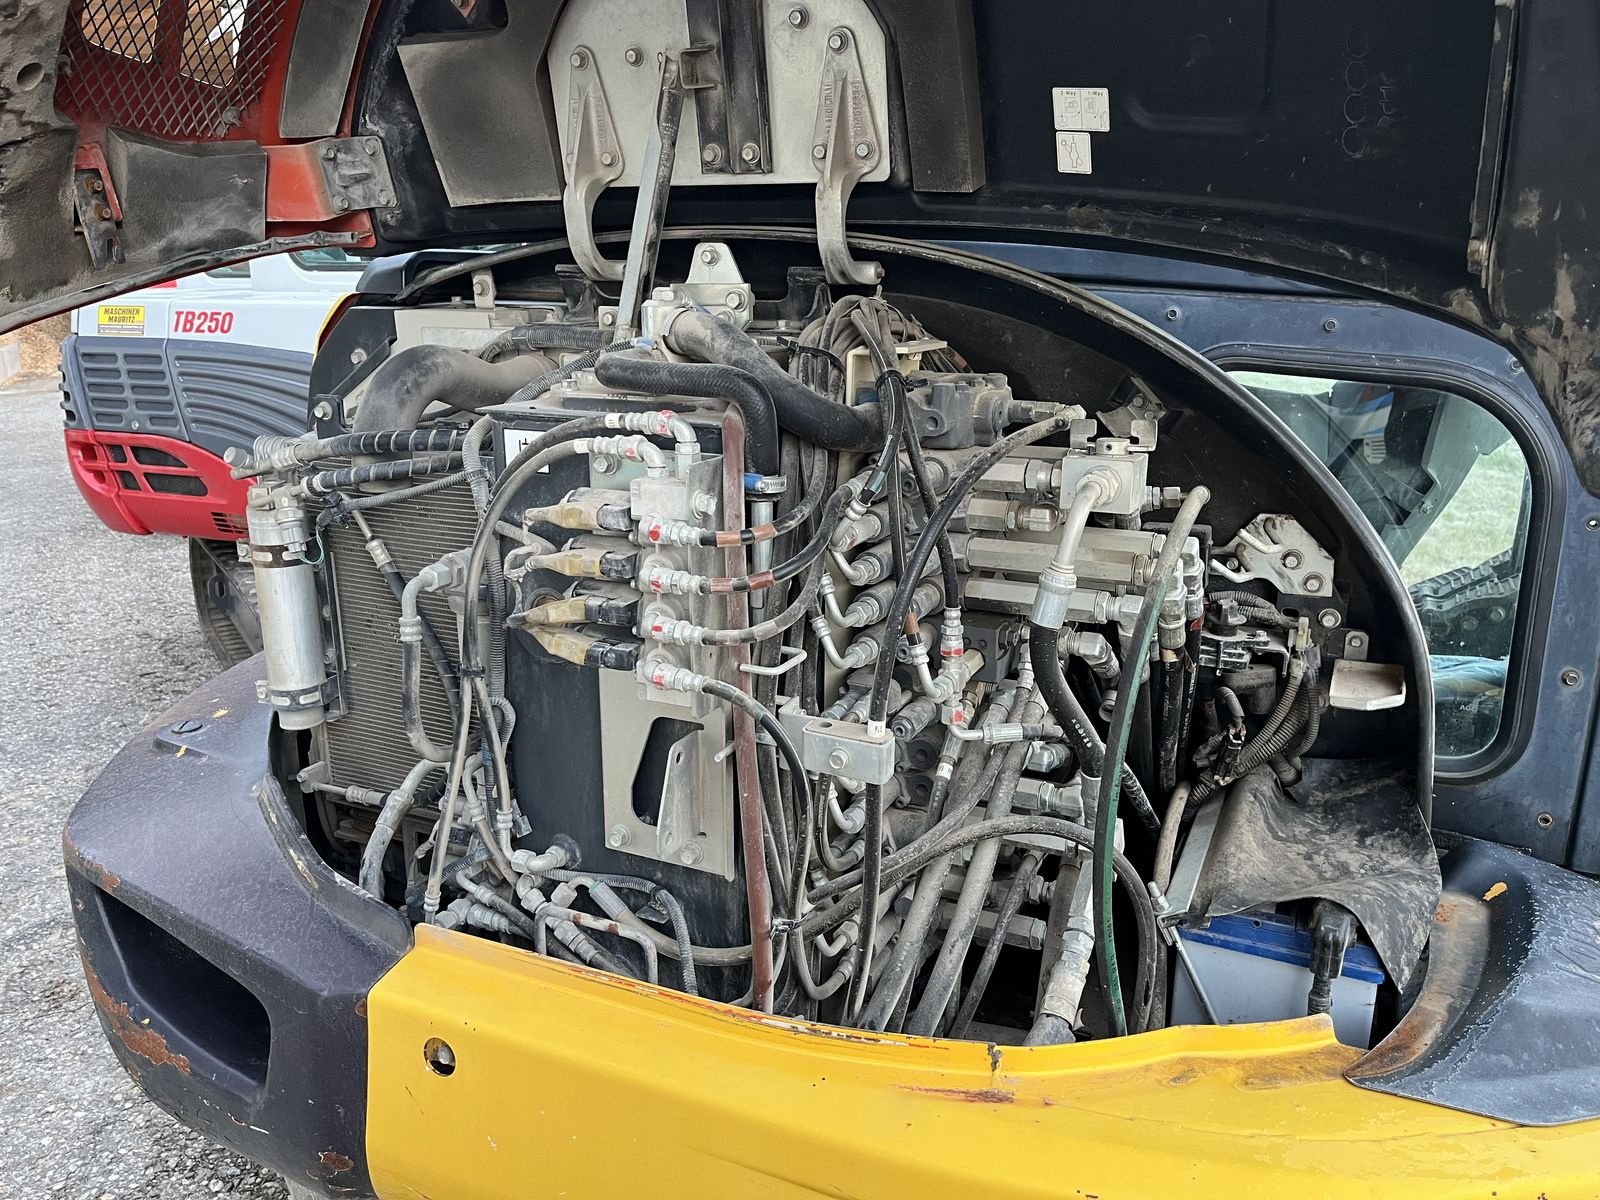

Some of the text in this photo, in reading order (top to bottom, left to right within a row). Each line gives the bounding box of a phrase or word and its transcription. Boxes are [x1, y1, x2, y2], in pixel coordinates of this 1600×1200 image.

[103, 307, 140, 316] MASCHINEN
[108, 315, 136, 323] MAURITZ
[173, 310, 234, 334] TB250
